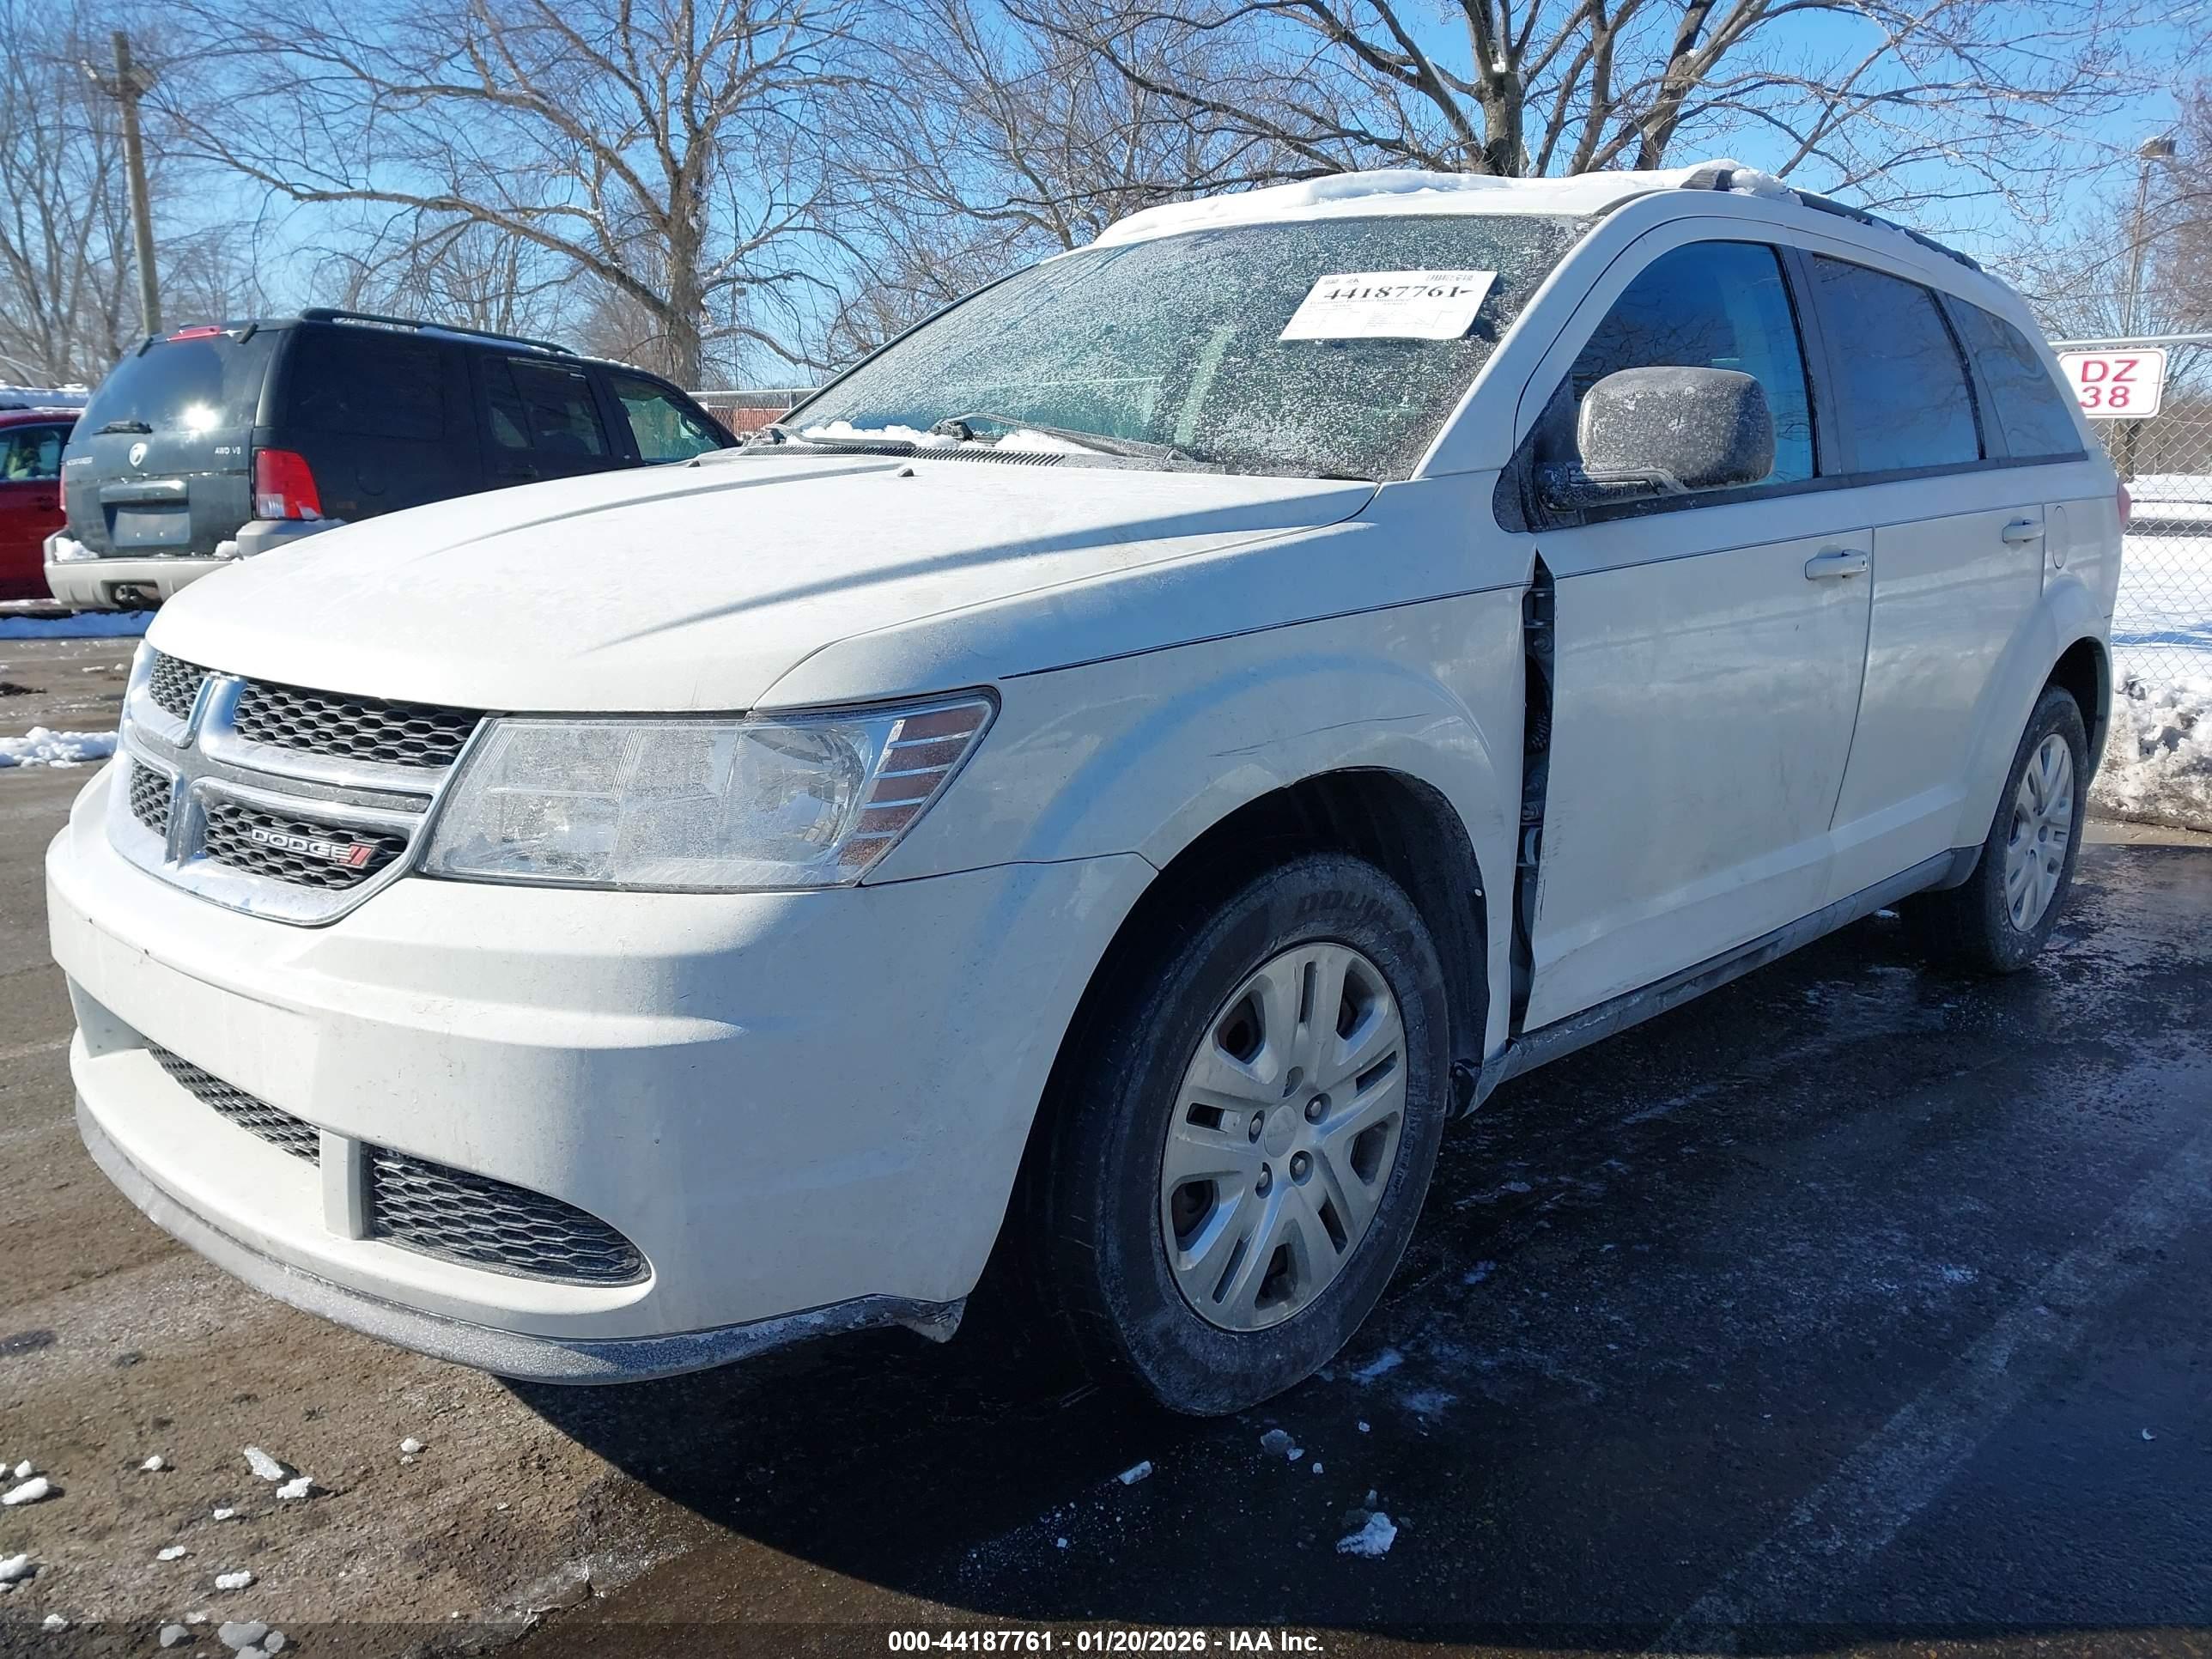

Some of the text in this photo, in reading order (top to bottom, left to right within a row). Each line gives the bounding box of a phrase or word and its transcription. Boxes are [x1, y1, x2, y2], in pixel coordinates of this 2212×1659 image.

[2081, 360, 2139, 382] DZ
[2078, 386, 2130, 408] 38
[251, 829, 352, 860] DODGE
